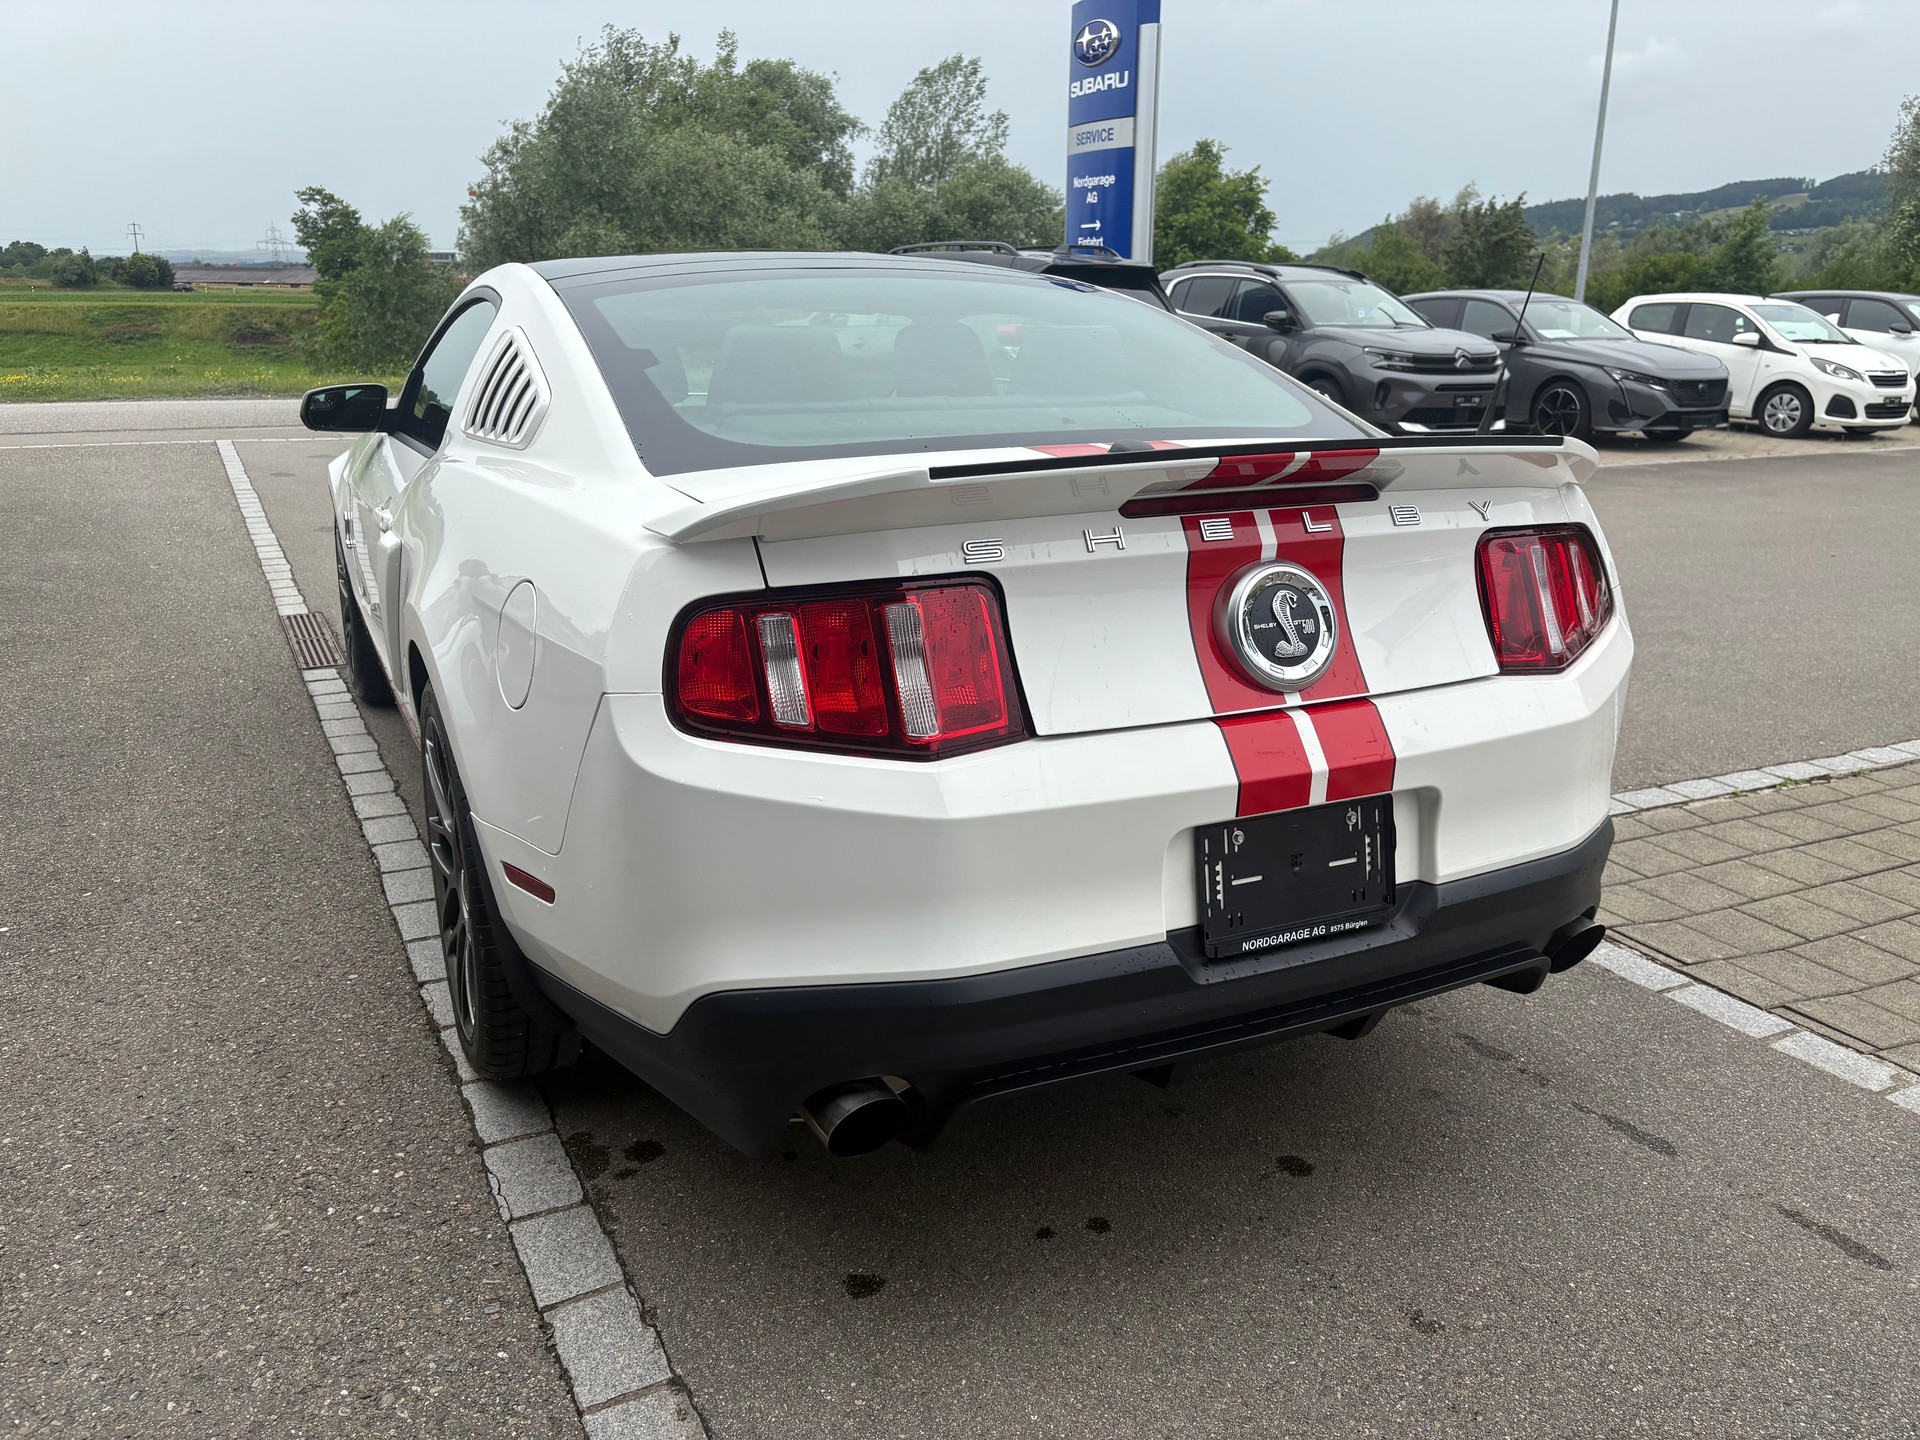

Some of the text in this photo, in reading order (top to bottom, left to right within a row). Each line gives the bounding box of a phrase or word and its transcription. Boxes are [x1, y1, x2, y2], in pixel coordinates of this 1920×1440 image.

[1070, 70, 1129, 98] SUBARU
[1076, 128, 1114, 146] SERVICE
[1073, 174, 1115, 188] Nordgarage
[1086, 192, 1098, 204] AG
[963, 499, 1493, 565] SHELBY
[1265, 572, 1296, 585] SVT
[1242, 920, 1367, 951] NORDGARAGE AG 8575 Bürglen
